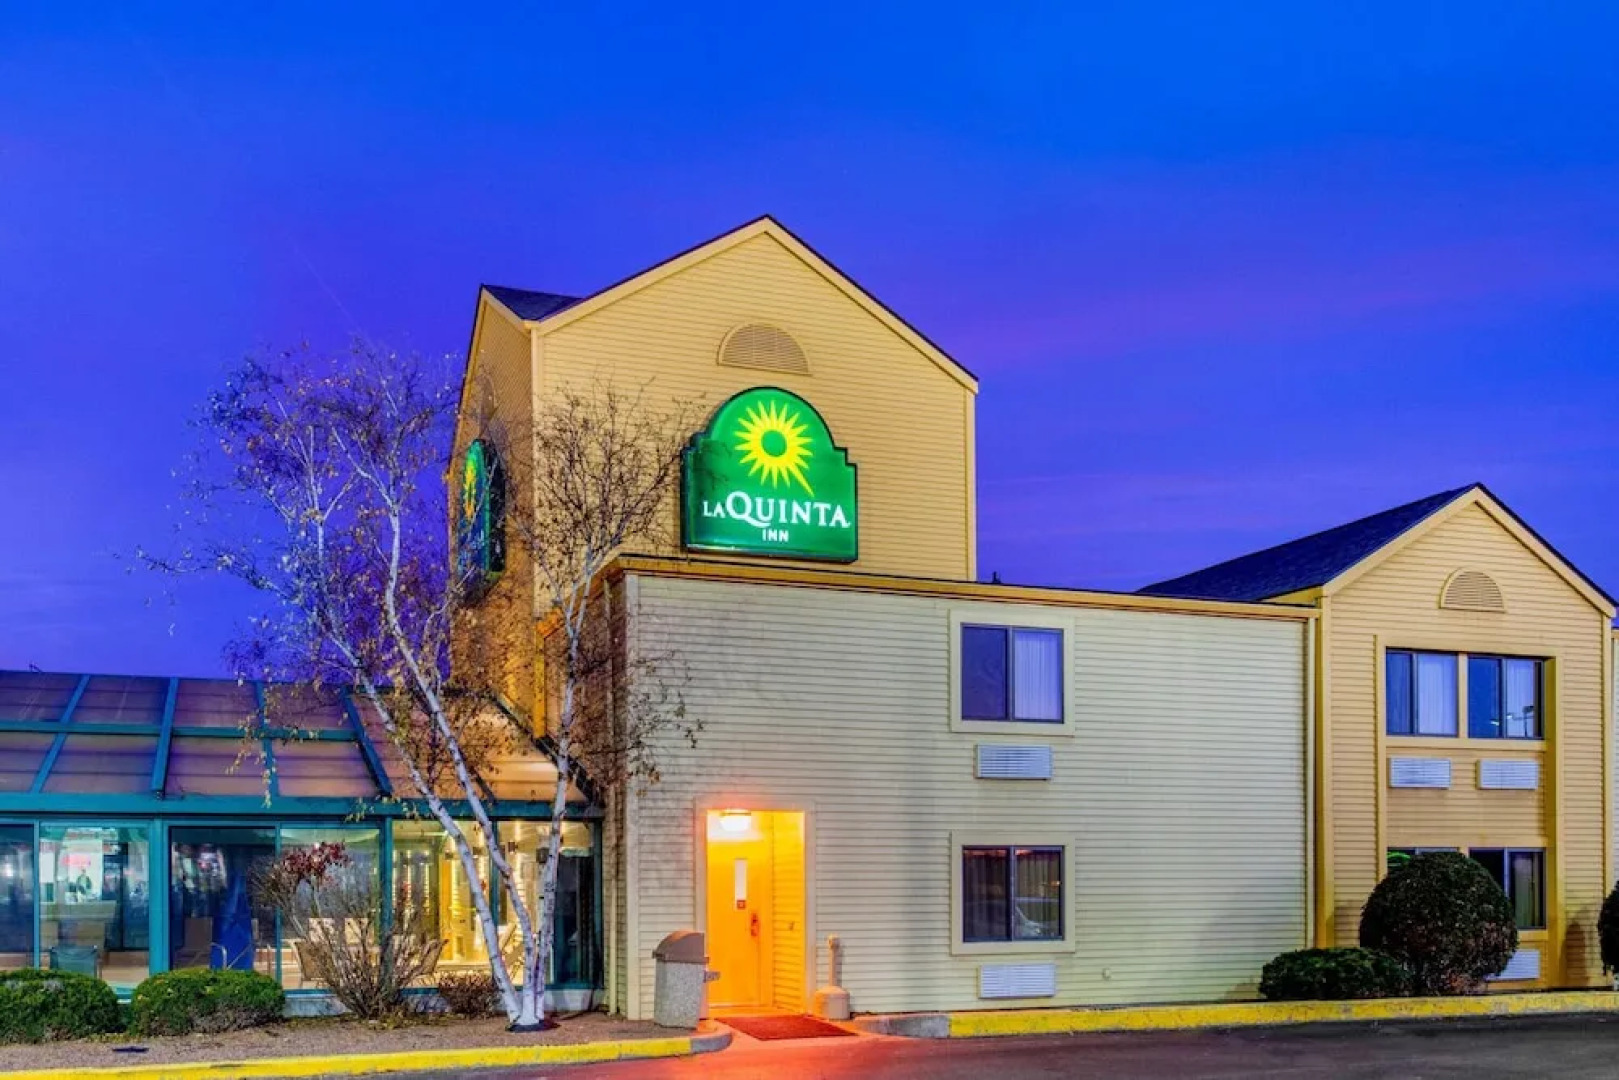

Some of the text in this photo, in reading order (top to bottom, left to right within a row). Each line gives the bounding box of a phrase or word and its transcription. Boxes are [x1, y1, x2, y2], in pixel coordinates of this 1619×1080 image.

[703, 491, 851, 528] LA QUINTA
[762, 529, 789, 542] INN
